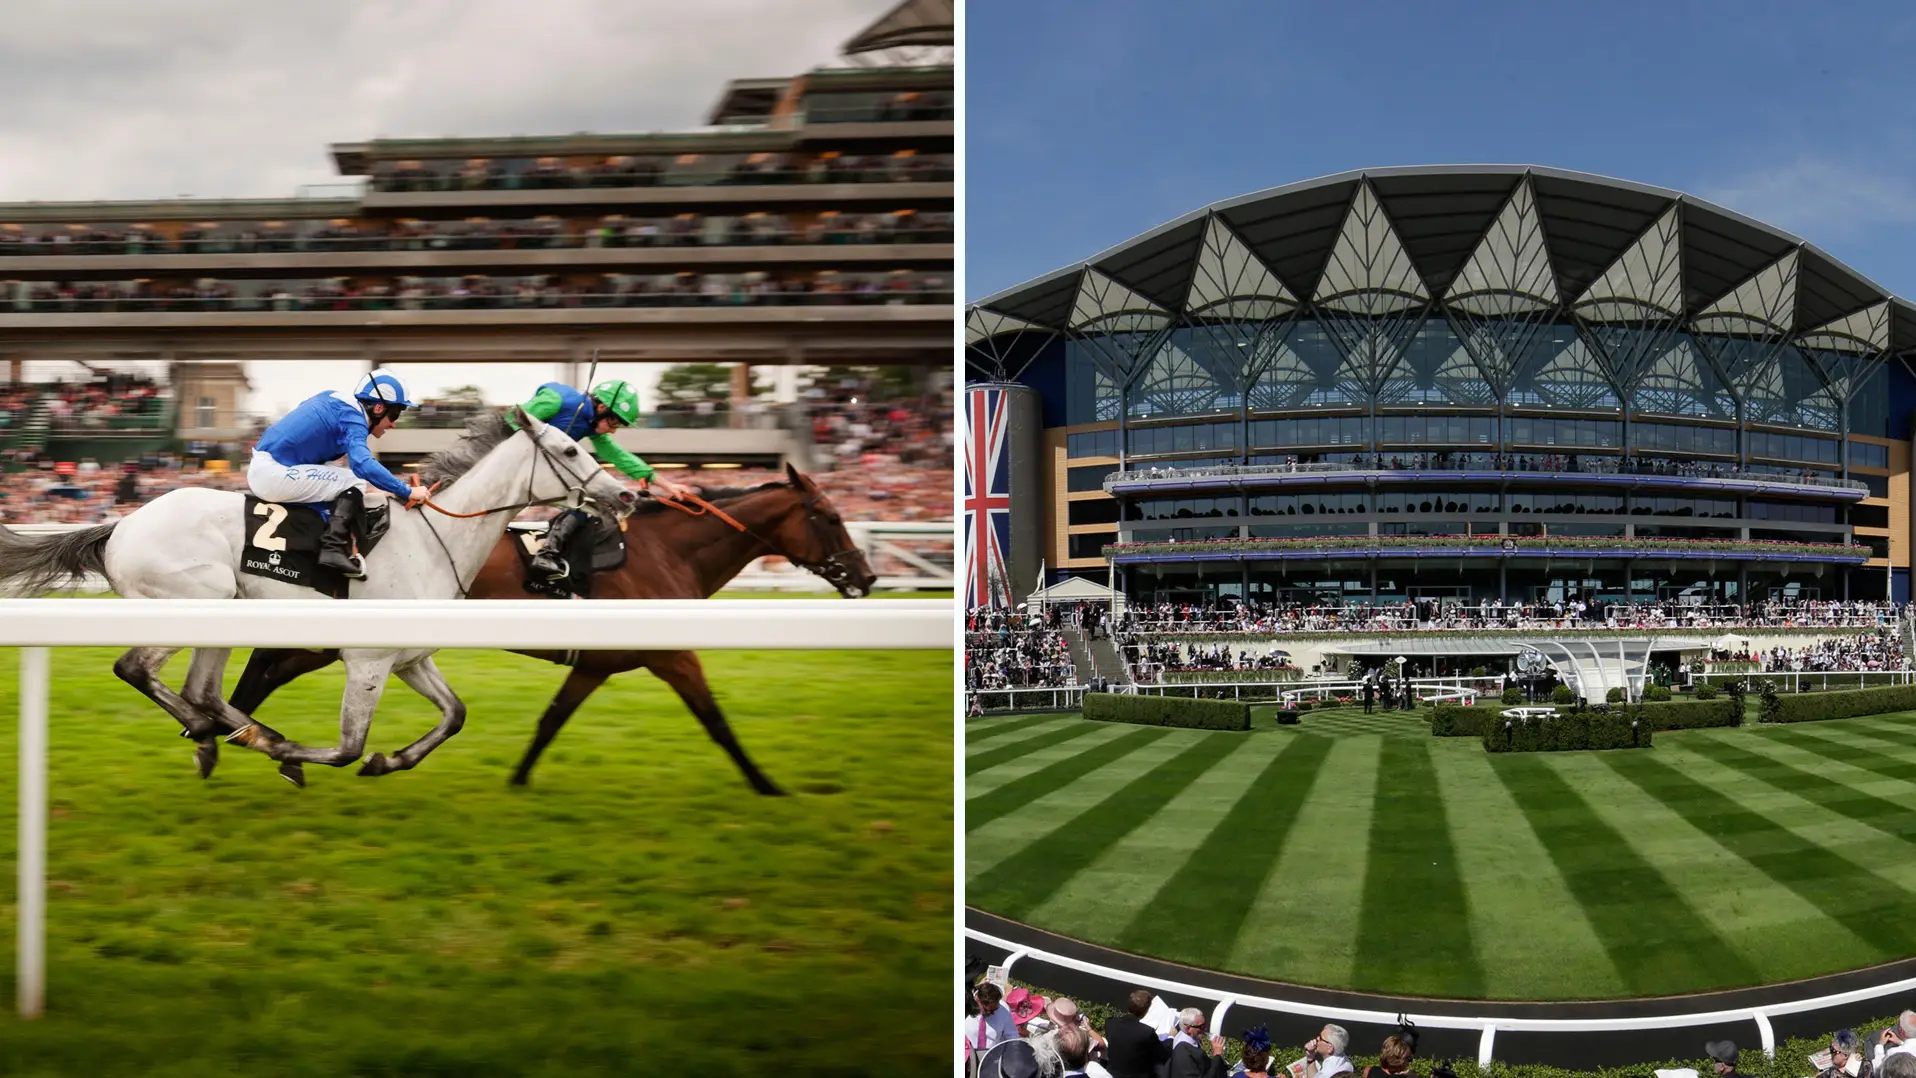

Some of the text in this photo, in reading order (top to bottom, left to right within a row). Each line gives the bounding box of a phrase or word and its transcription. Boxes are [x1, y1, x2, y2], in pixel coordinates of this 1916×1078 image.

[285, 468, 339, 482] R. Hills
[252, 502, 288, 551] 2
[246, 560, 300, 578] ROYAL ASCOT
